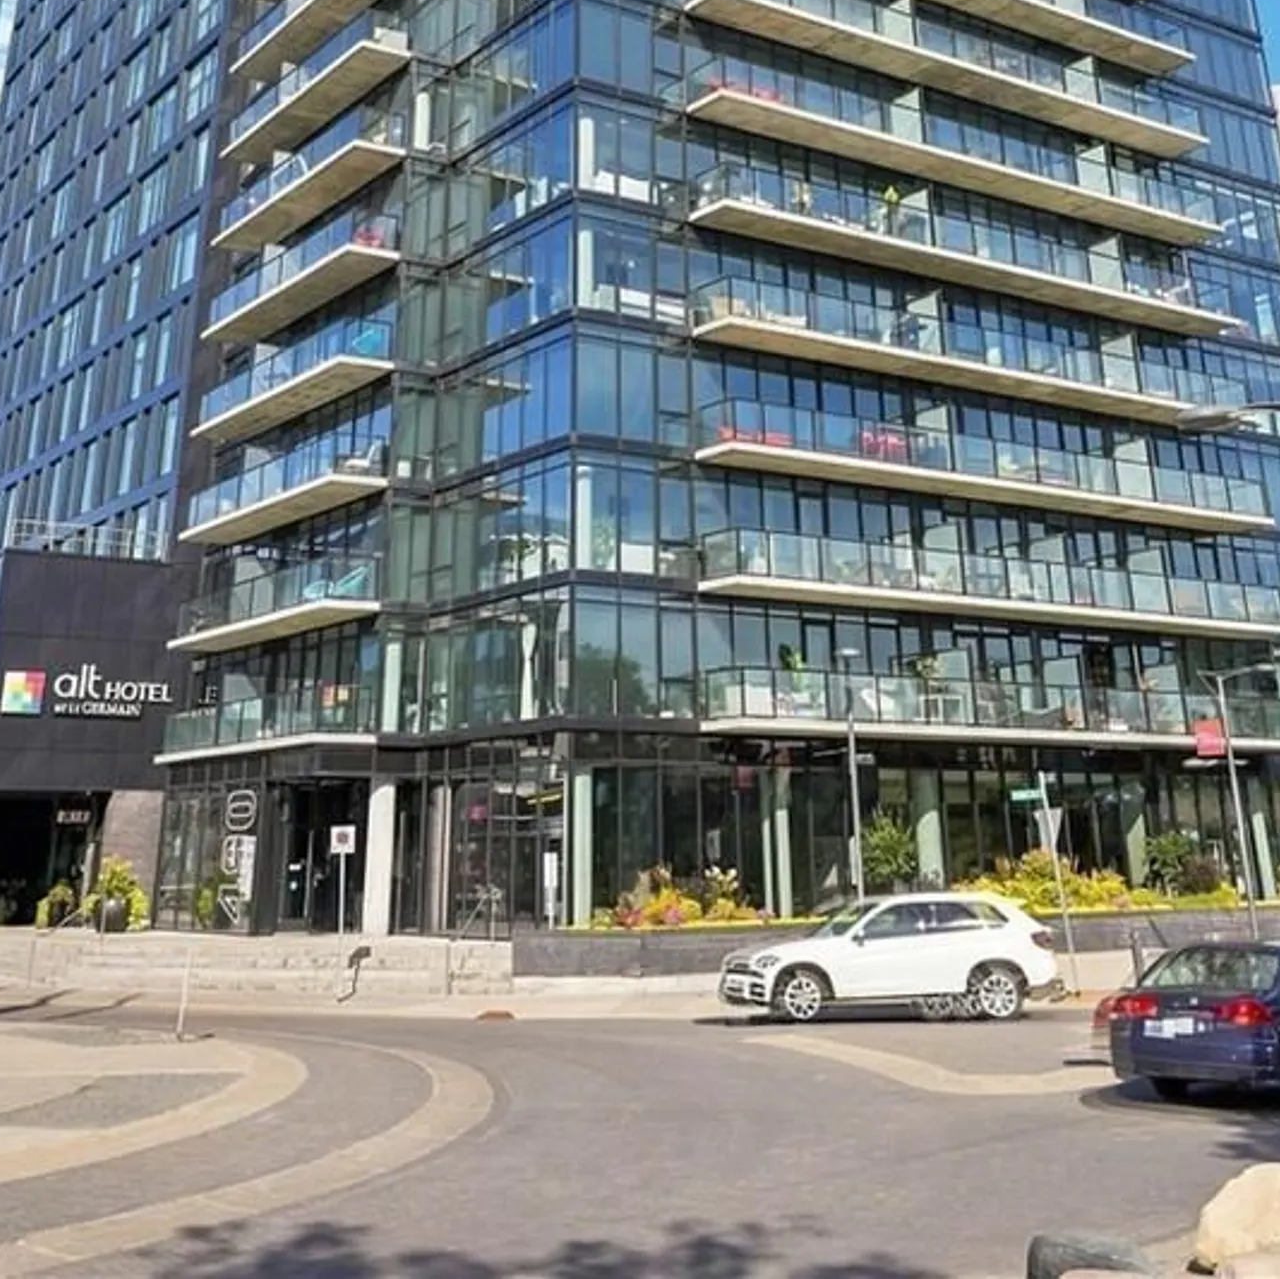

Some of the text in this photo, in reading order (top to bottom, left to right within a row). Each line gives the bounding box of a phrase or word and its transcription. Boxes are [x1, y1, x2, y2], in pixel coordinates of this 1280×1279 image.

[53, 663, 173, 703] alt HOTEL
[81, 702, 142, 717] GERMAIN
